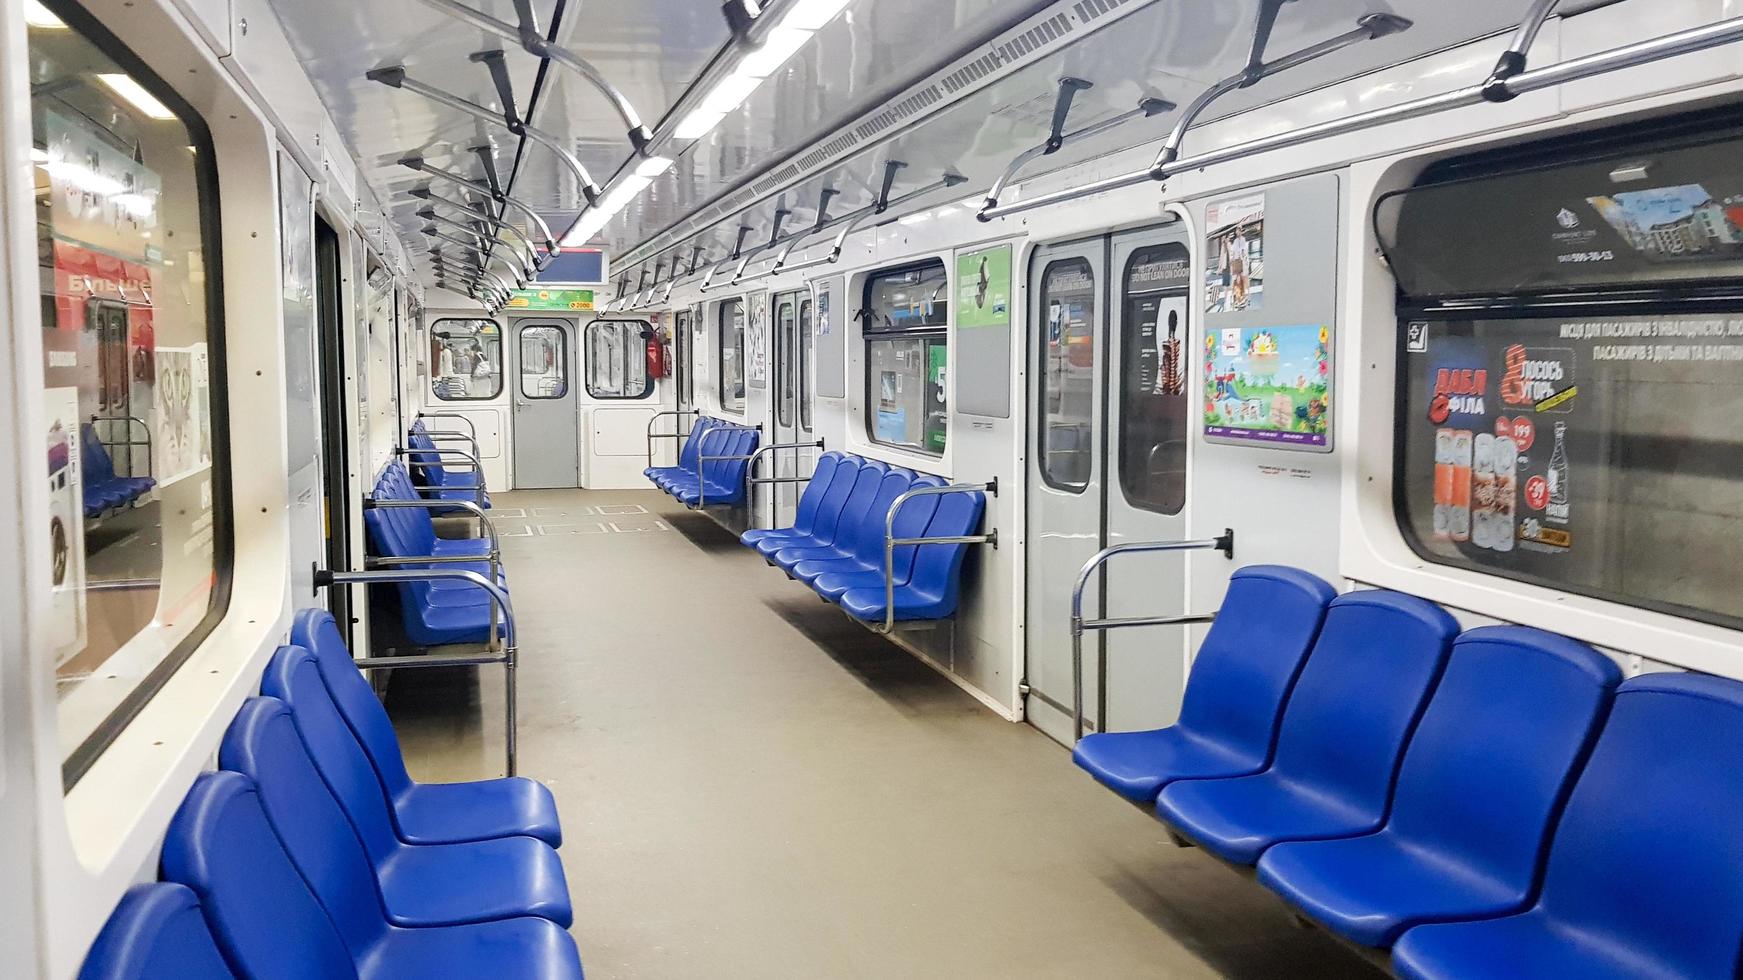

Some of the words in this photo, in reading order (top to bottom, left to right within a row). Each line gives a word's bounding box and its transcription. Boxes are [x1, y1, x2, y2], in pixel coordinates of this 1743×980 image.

[1560, 323, 1584, 339] МІСЦЯ
[1584, 323, 1600, 339] ДЛЯ
[1593, 345, 1646, 360] ПАСАЖИРІВ
[1520, 360, 1563, 380] ЛОСОСЬ
[1434, 368, 1487, 398] ДАБЛ
[1449, 395, 1485, 415] ФІЛА
